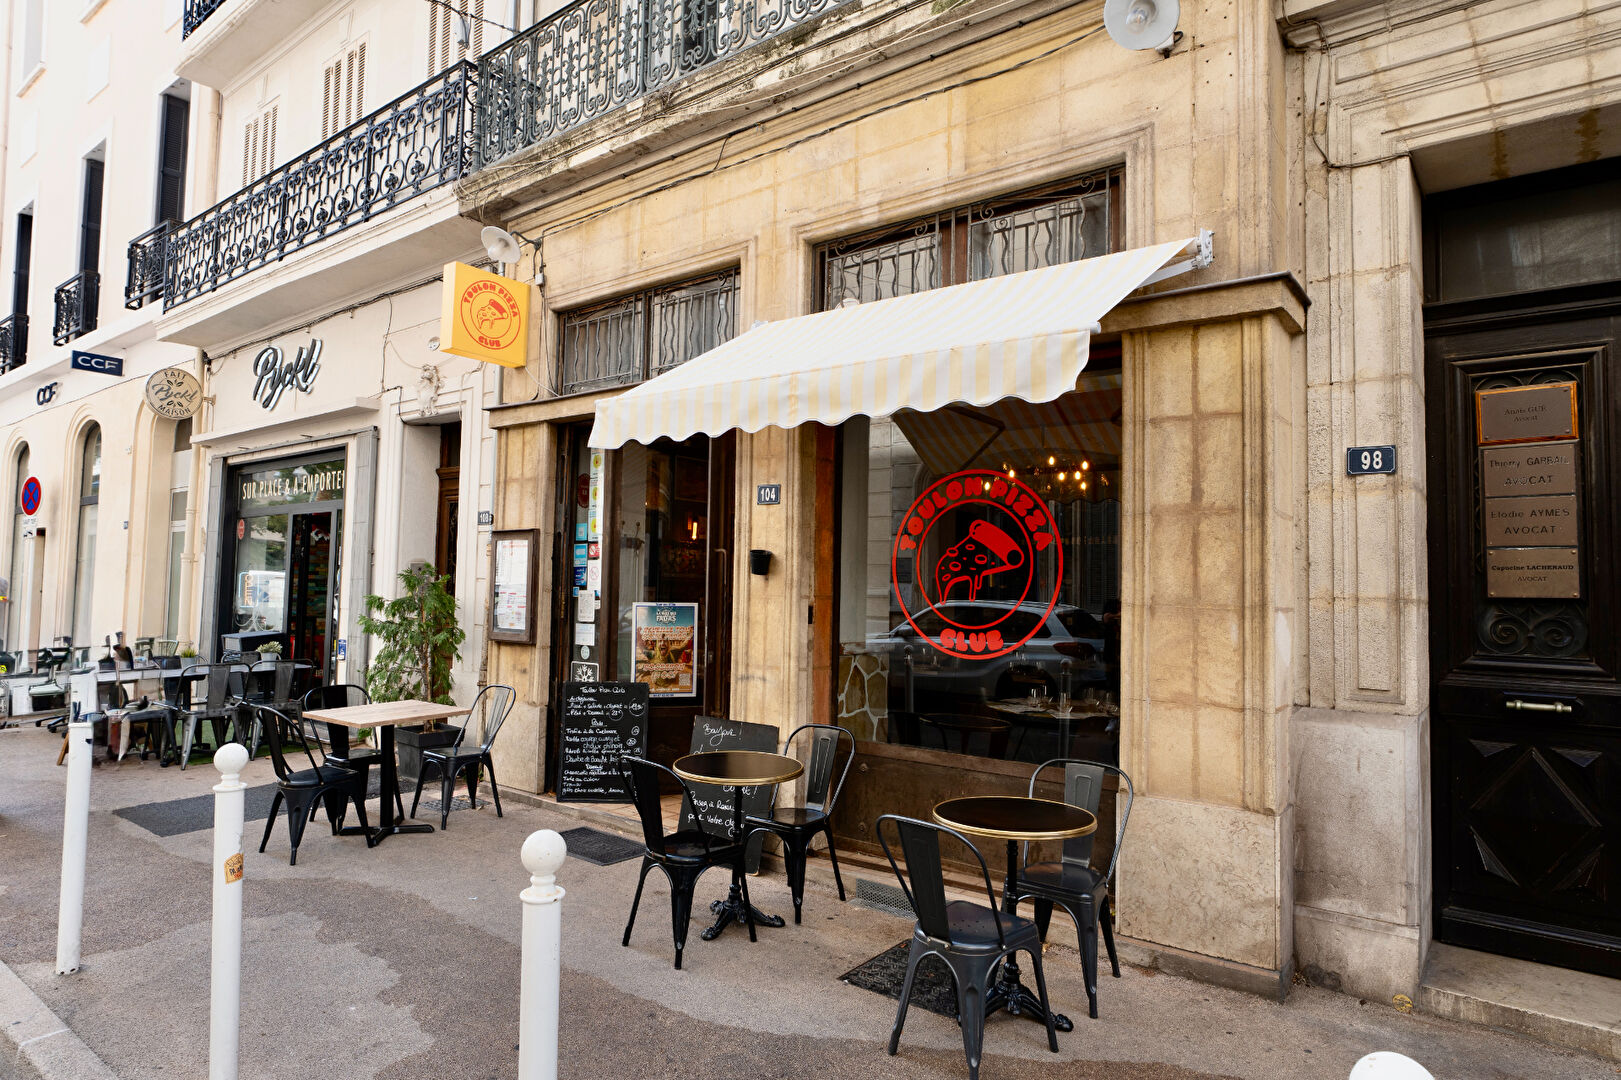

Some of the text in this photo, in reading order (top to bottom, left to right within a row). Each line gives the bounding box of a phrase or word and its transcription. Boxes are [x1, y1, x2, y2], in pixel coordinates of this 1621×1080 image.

[463, 282, 519, 318] TOULON PIZZA
[478, 335, 501, 347] CLUB
[77, 355, 119, 370] CCF
[164, 371, 186, 380] FAIT
[36, 381, 58, 406] CCF
[158, 404, 191, 416] MAISON
[1361, 450, 1383, 470] 98
[1489, 459, 1521, 470] Thierry
[1504, 475, 1554, 486] AVOCAT
[242, 481, 257, 500] SUR
[259, 478, 283, 498] PLACE
[285, 478, 291, 495] &
[760, 487, 776, 502] 104
[900, 476, 1054, 551] TOULON PIZZA
[1529, 508, 1570, 518] AYMES
[1504, 525, 1557, 535] AVOCAT
[939, 627, 1004, 653] CLUB
